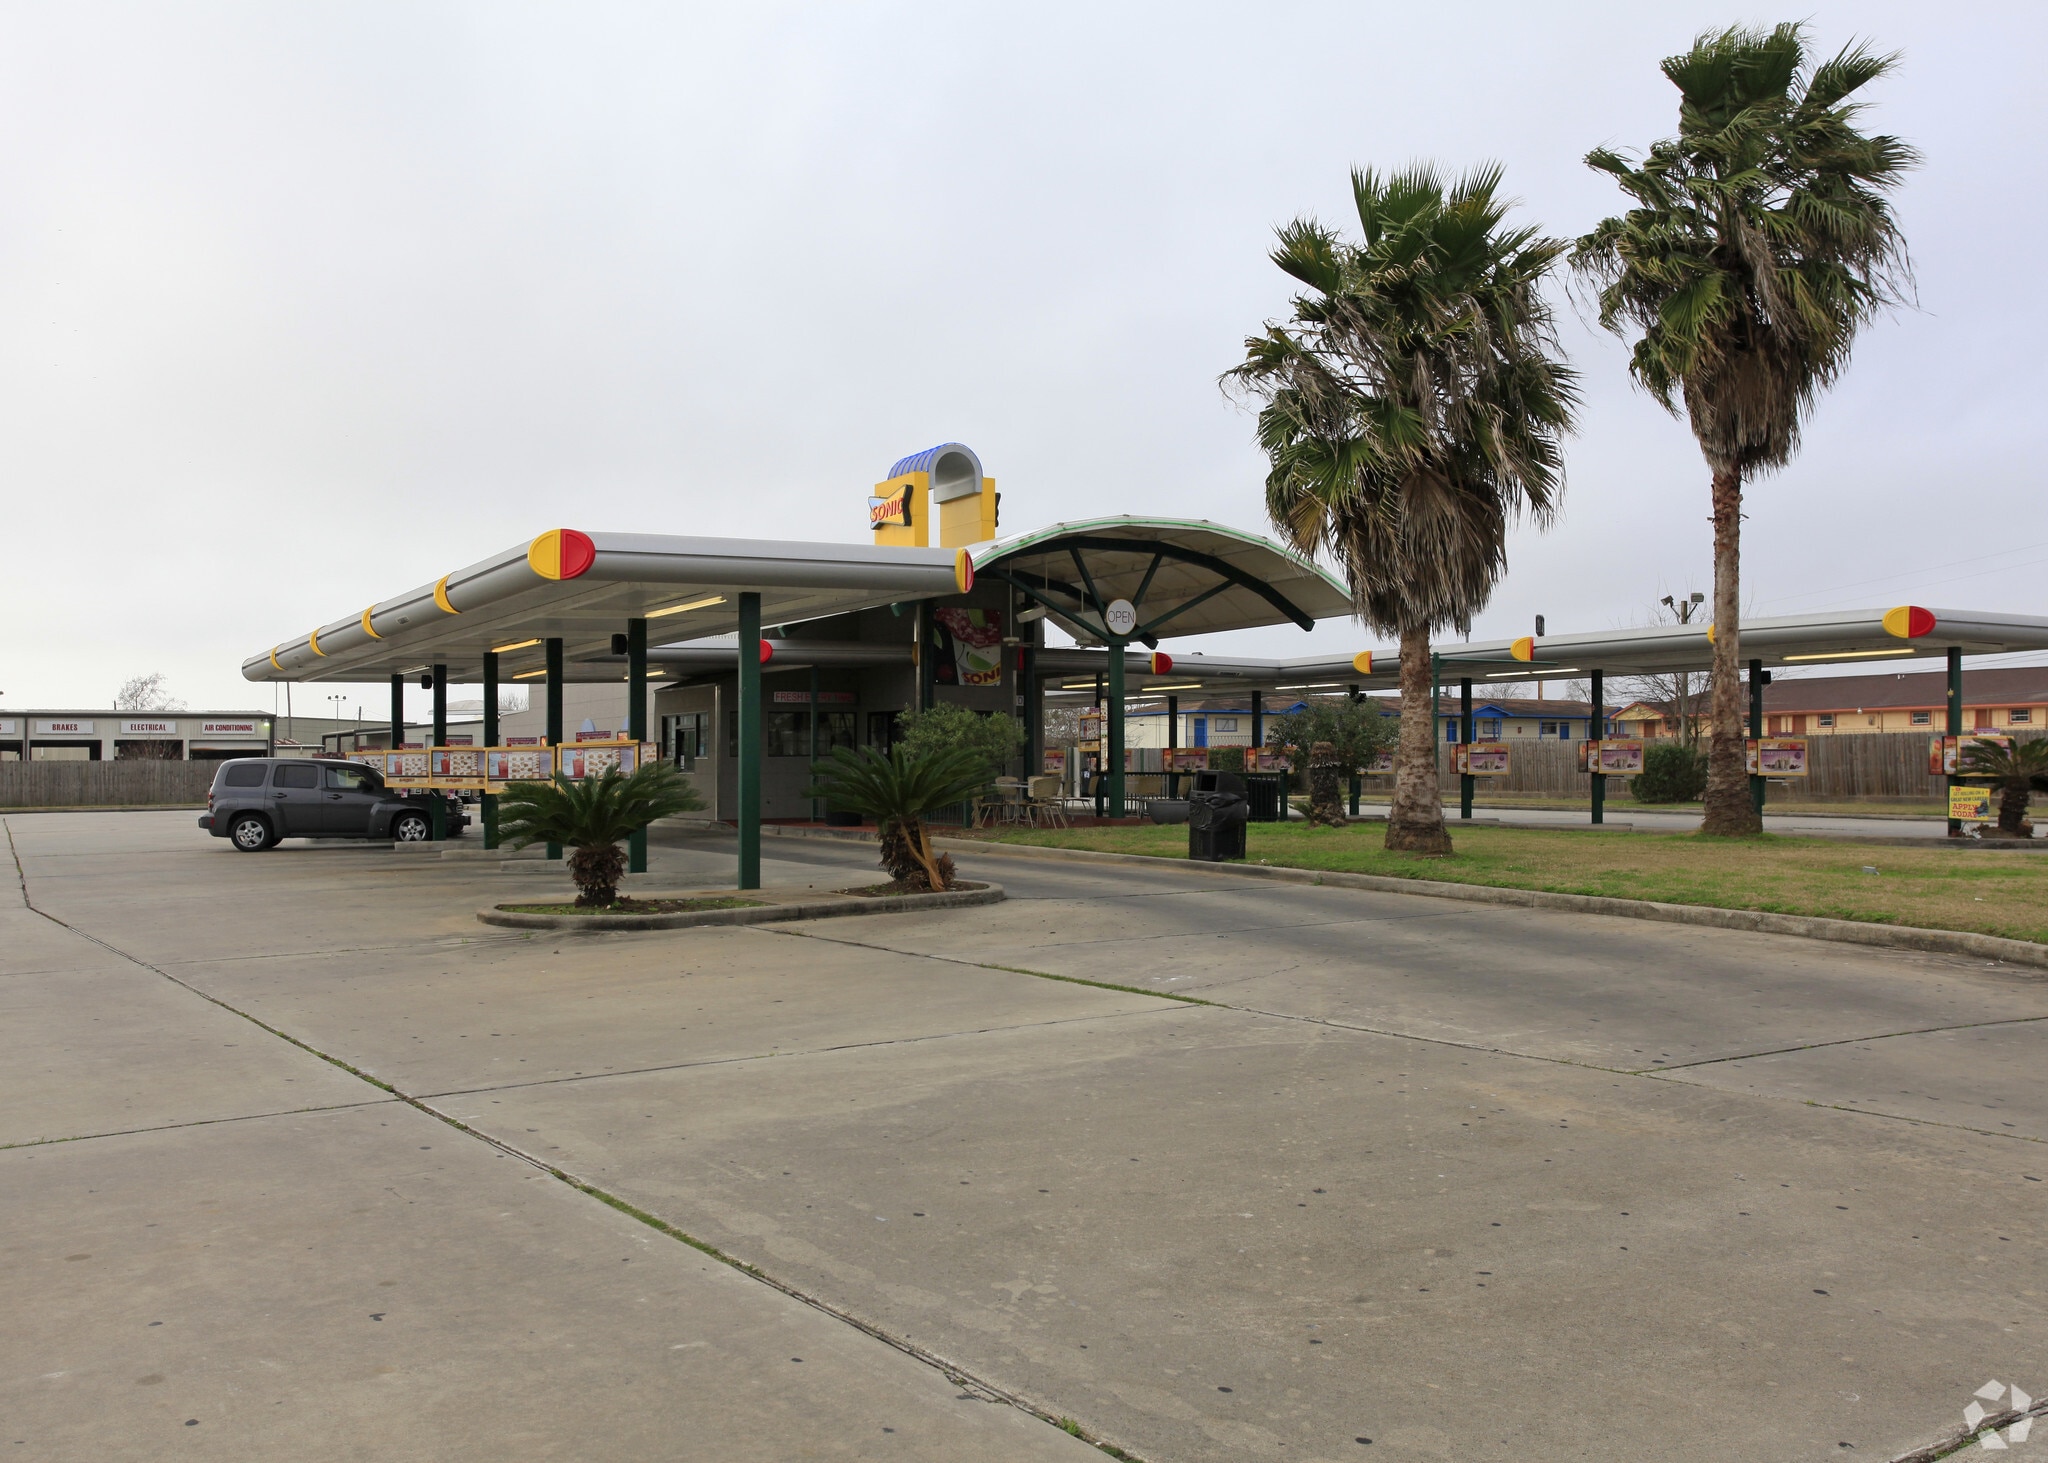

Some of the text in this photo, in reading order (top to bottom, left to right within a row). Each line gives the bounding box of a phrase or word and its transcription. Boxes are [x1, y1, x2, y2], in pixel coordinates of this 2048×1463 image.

[871, 497, 904, 522] SONIC
[1108, 611, 1134, 623] OPEN
[775, 692, 802, 702] FRESH
[805, 692, 832, 702] EERY
[52, 723, 78, 731] BRAKES
[130, 723, 166, 731] ELECTRICAL
[1952, 810, 1977, 818] TODAY
